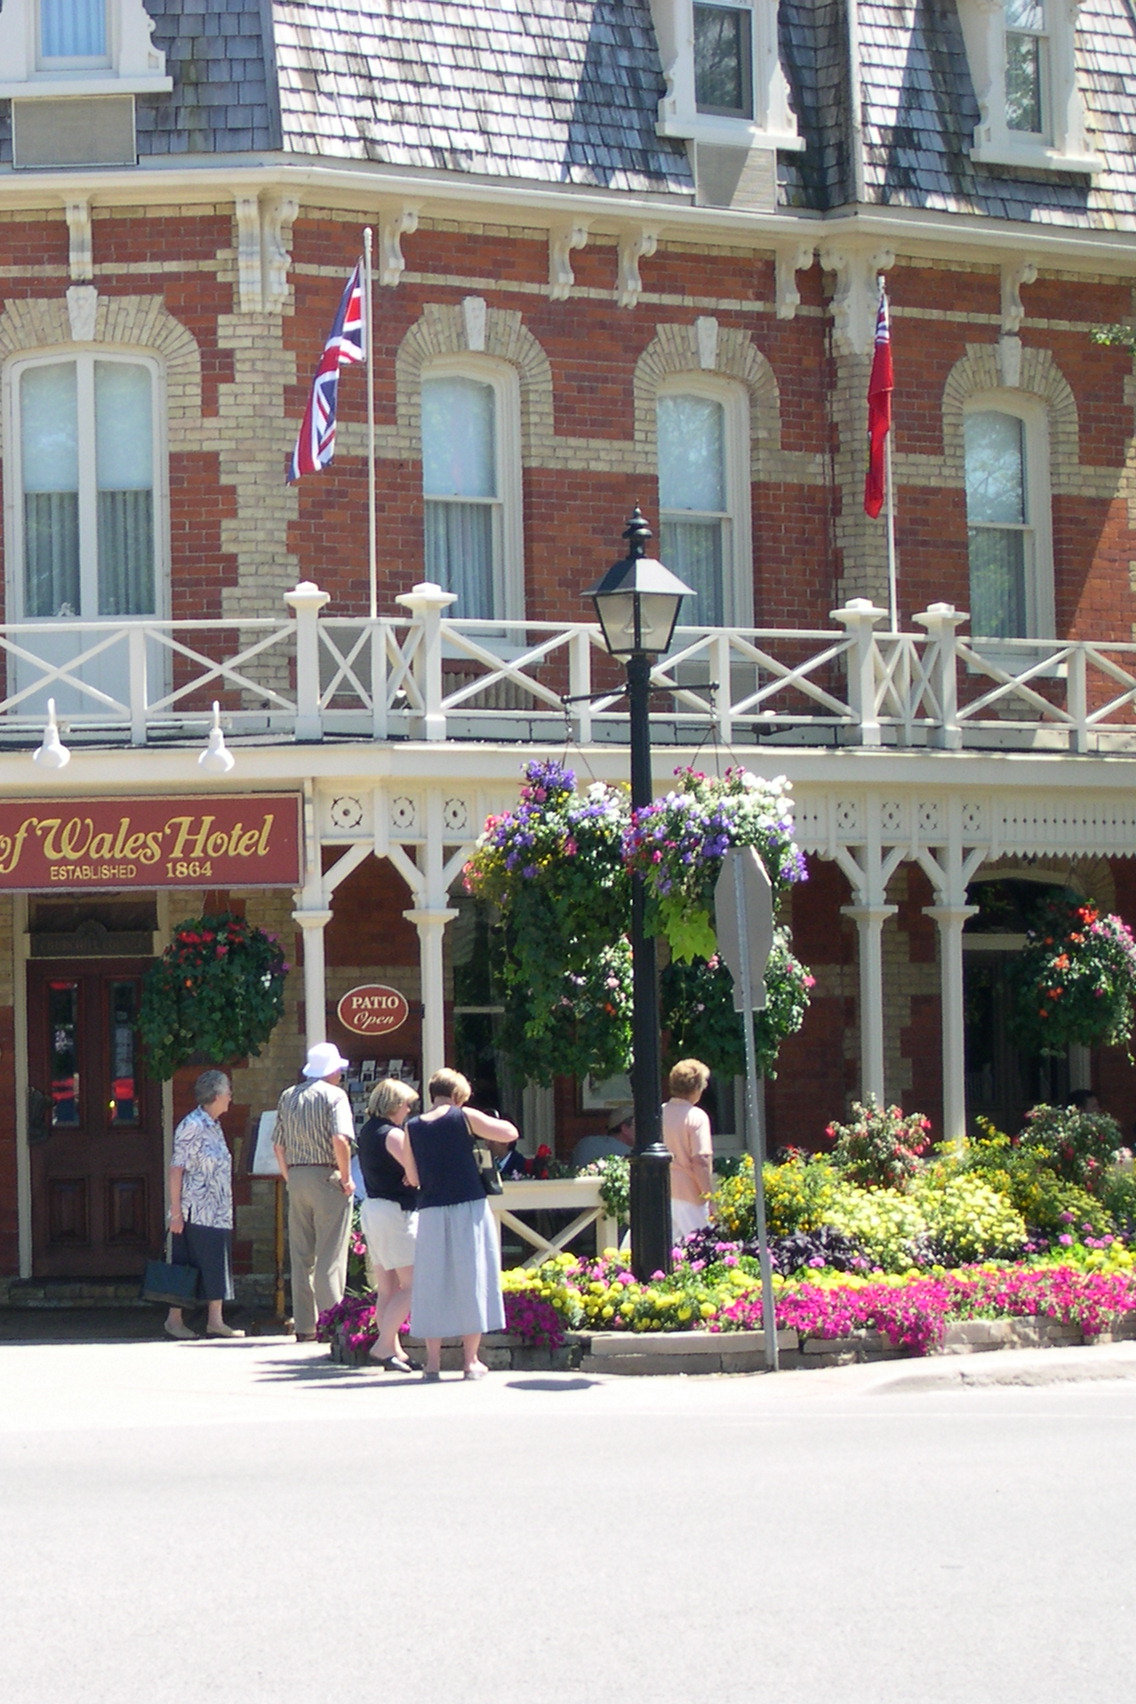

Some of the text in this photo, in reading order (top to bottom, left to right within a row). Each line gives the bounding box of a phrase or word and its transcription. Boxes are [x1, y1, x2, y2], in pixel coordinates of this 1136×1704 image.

[35, 816, 162, 864] Wales
[164, 813, 274, 858] Hotel
[50, 861, 213, 880] ESTABLISHED 1864
[351, 995, 399, 1009] PATIO
[353, 1011, 394, 1029] Open
